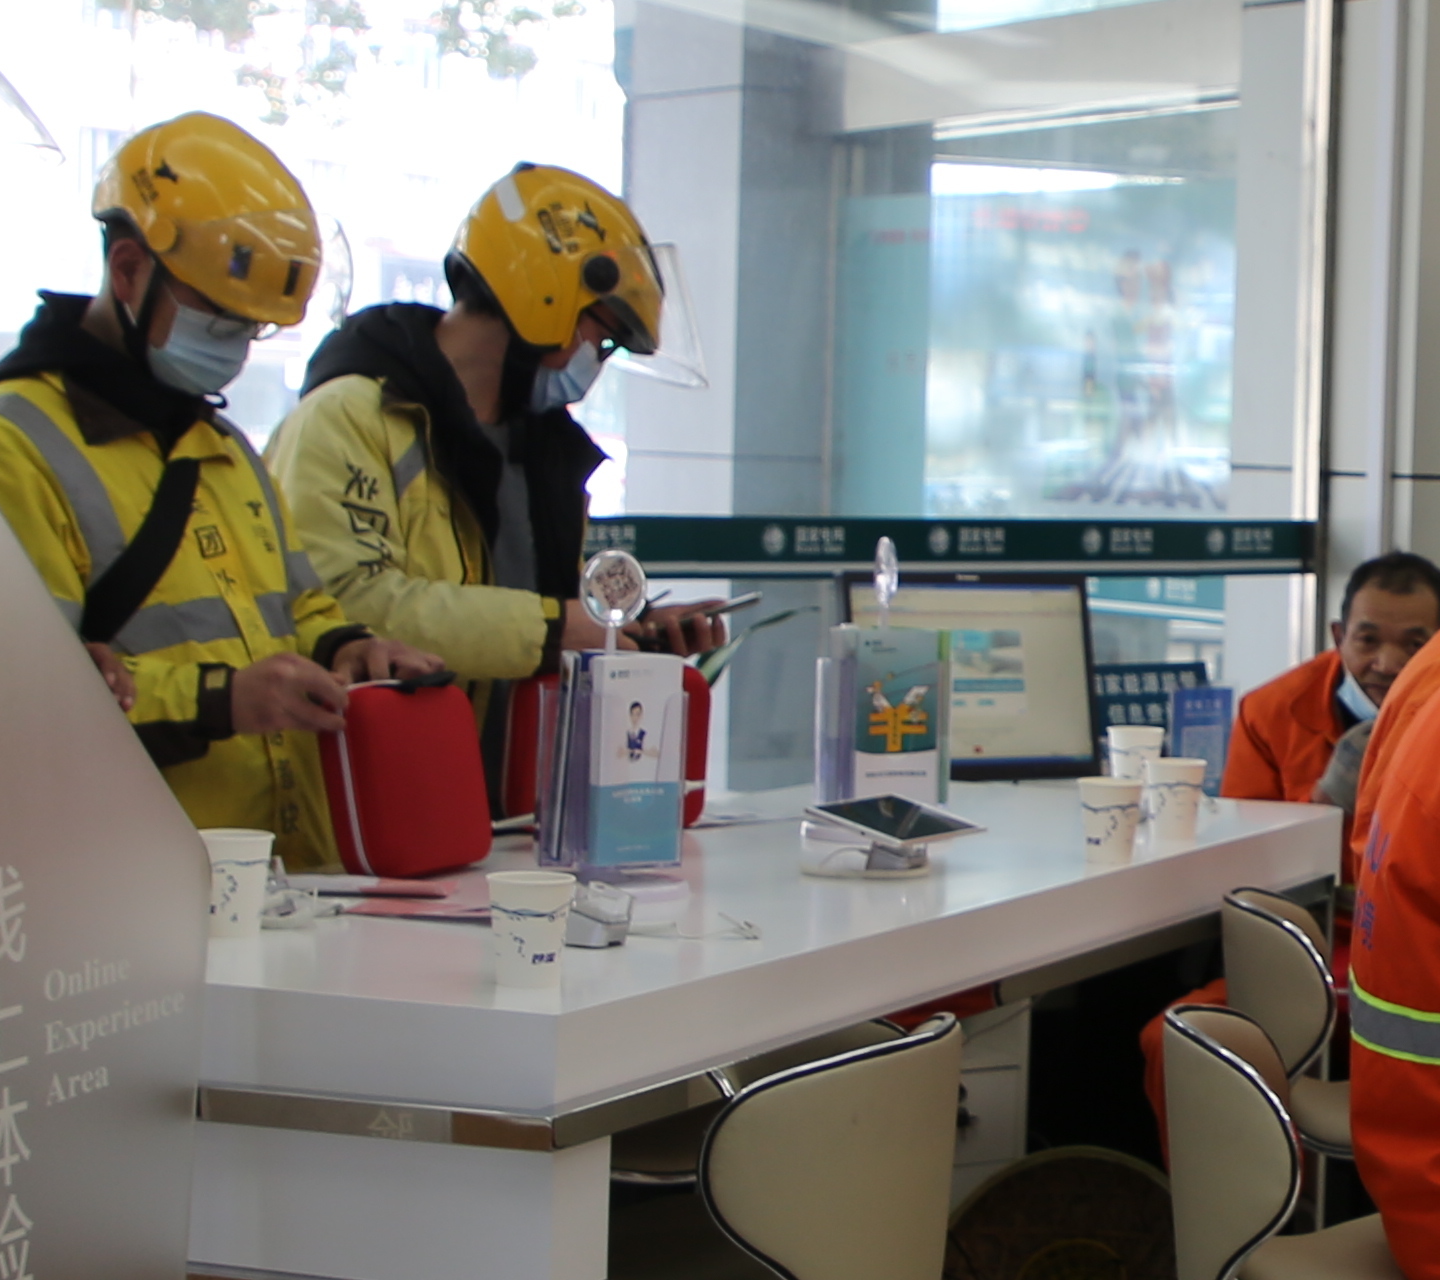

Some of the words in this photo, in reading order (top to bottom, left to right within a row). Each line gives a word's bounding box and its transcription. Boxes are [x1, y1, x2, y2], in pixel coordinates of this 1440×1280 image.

[44, 958, 131, 1002] Online
[44, 991, 185, 1055] Experience
[46, 1066, 110, 1107] Area
